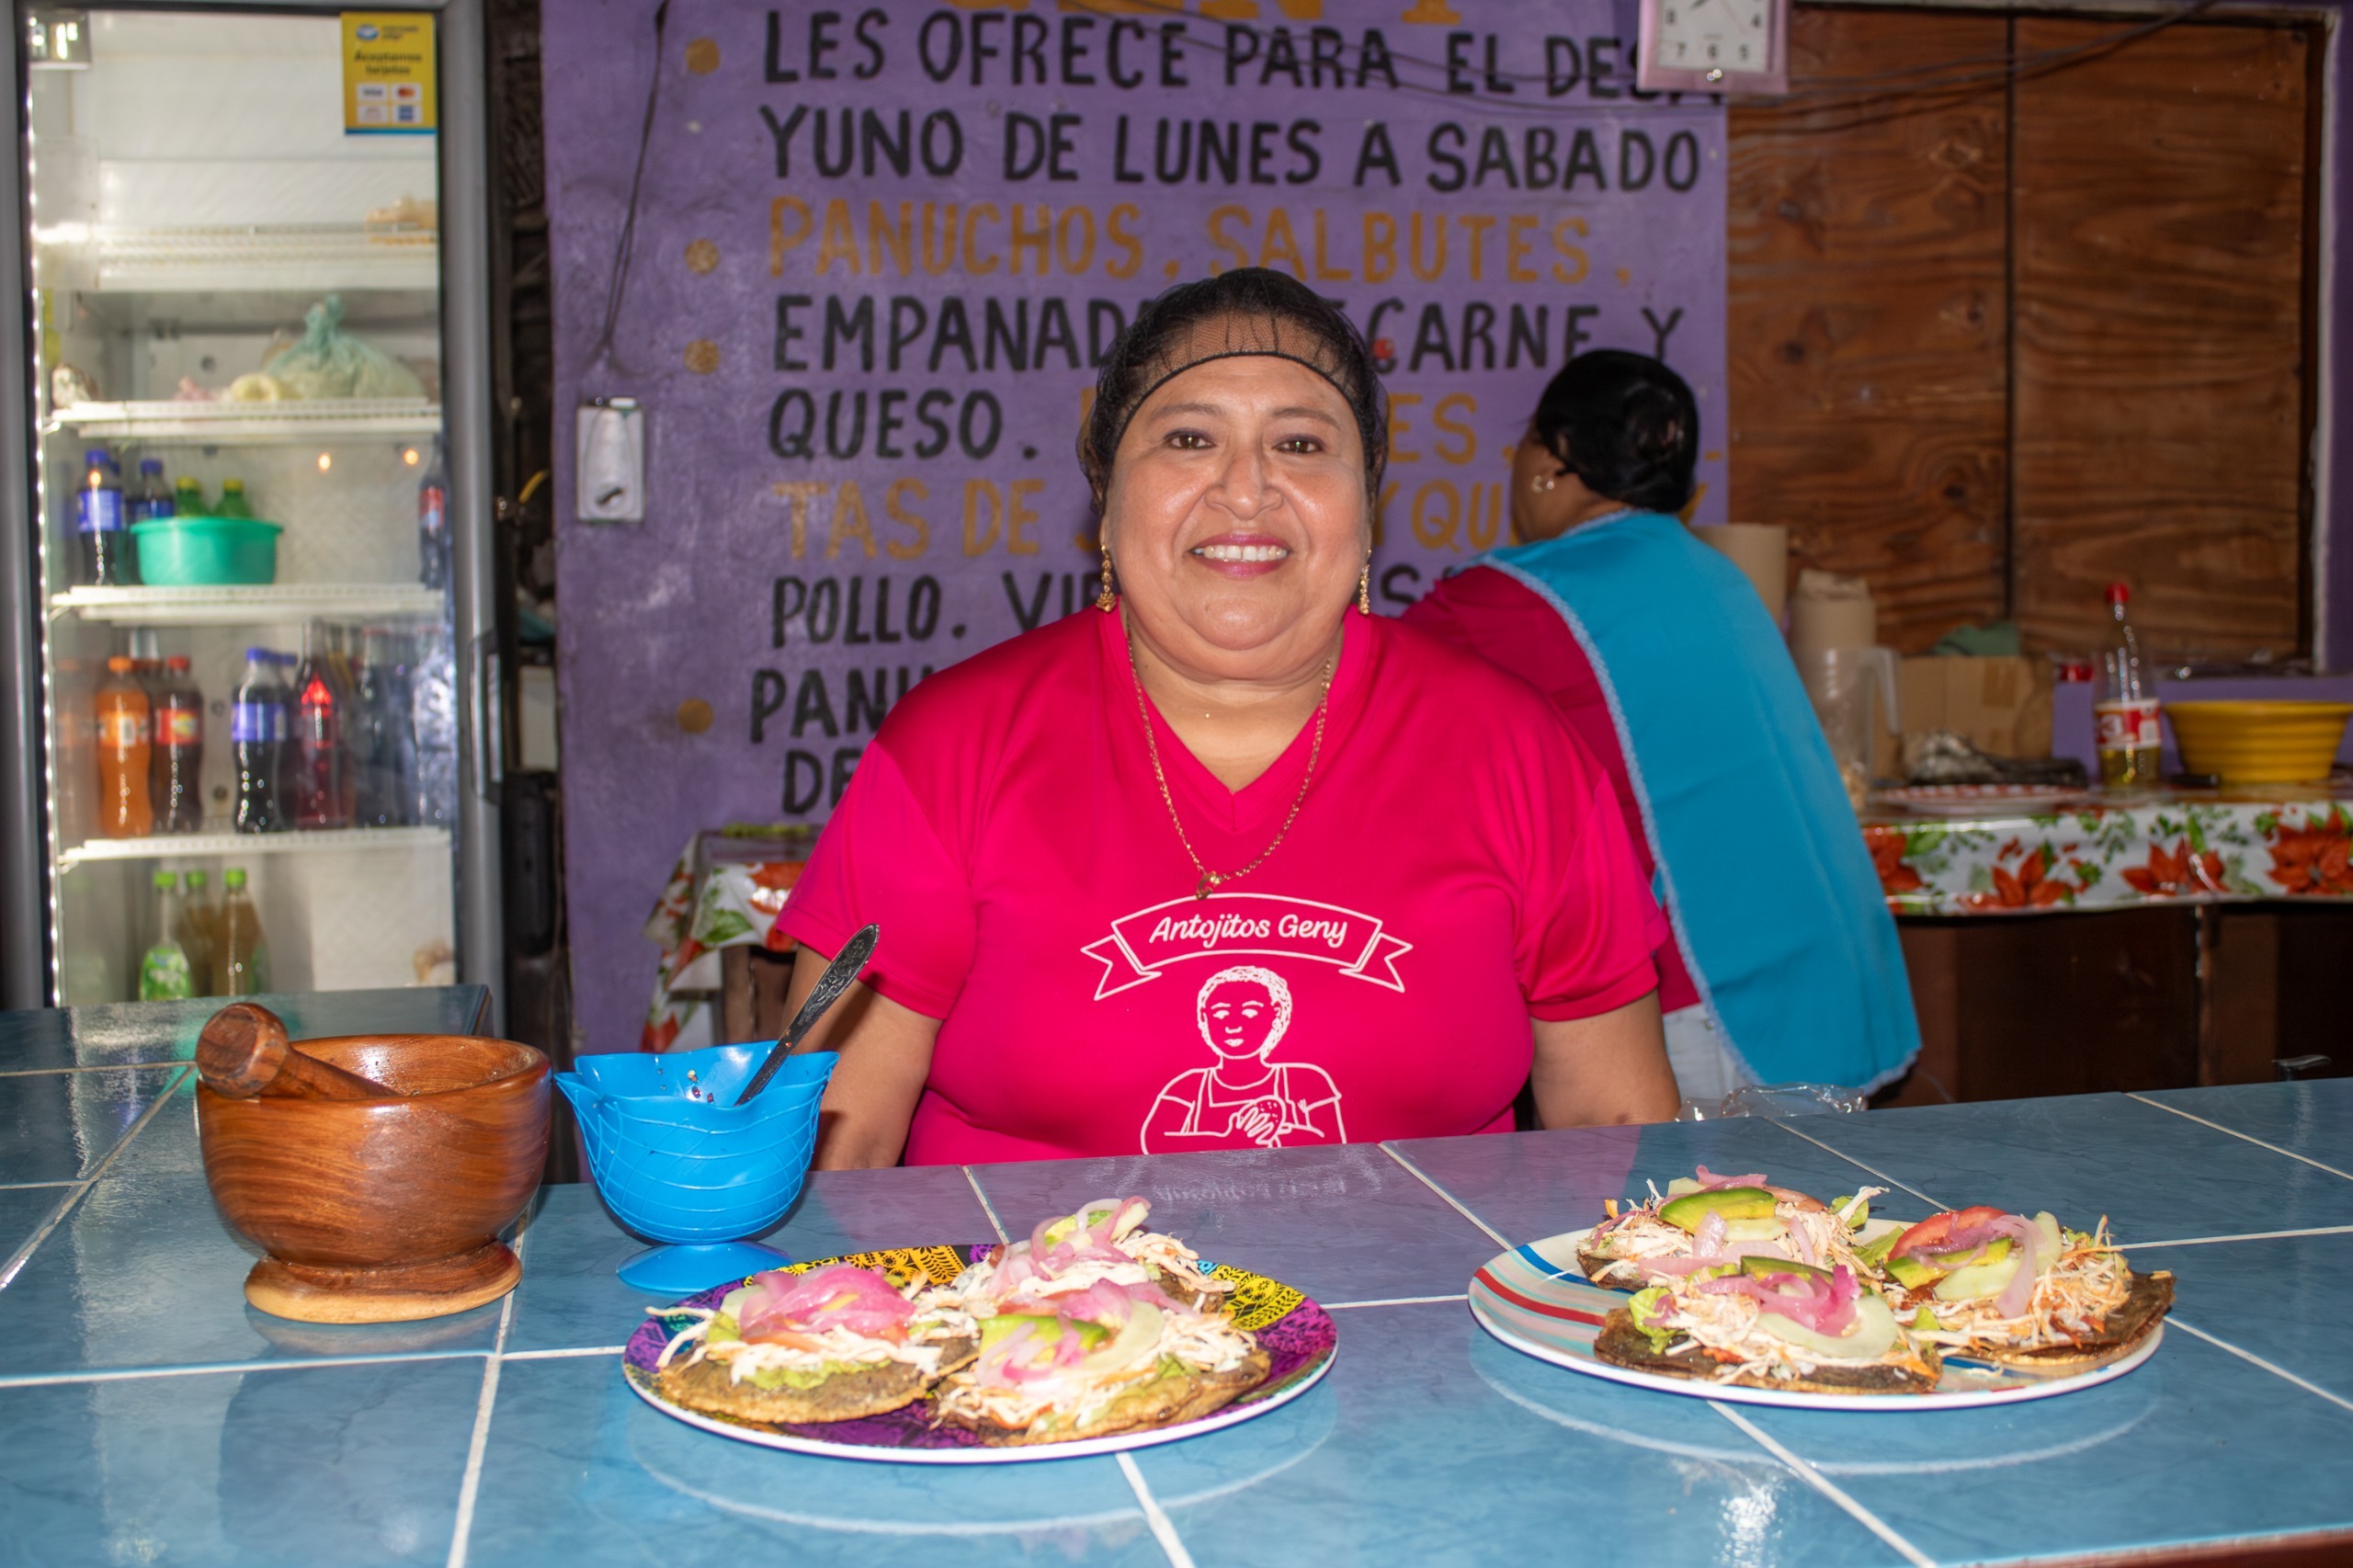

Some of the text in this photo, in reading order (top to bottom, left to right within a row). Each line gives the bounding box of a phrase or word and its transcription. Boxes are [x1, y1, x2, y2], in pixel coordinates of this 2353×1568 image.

[765, 10, 888, 84] LES
[919, 11, 1188, 87] OFRECE
[1226, 26, 1398, 89] PARA
[1448, 32, 1514, 94] EL
[759, 105, 1699, 193] YUNO DE LUNES A SABADO
[1642, 307, 1683, 366] Y
[771, 477, 929, 561] TAS
[962, 479, 1046, 557] DE
[1149, 914, 1347, 949] Antojitos Geny
